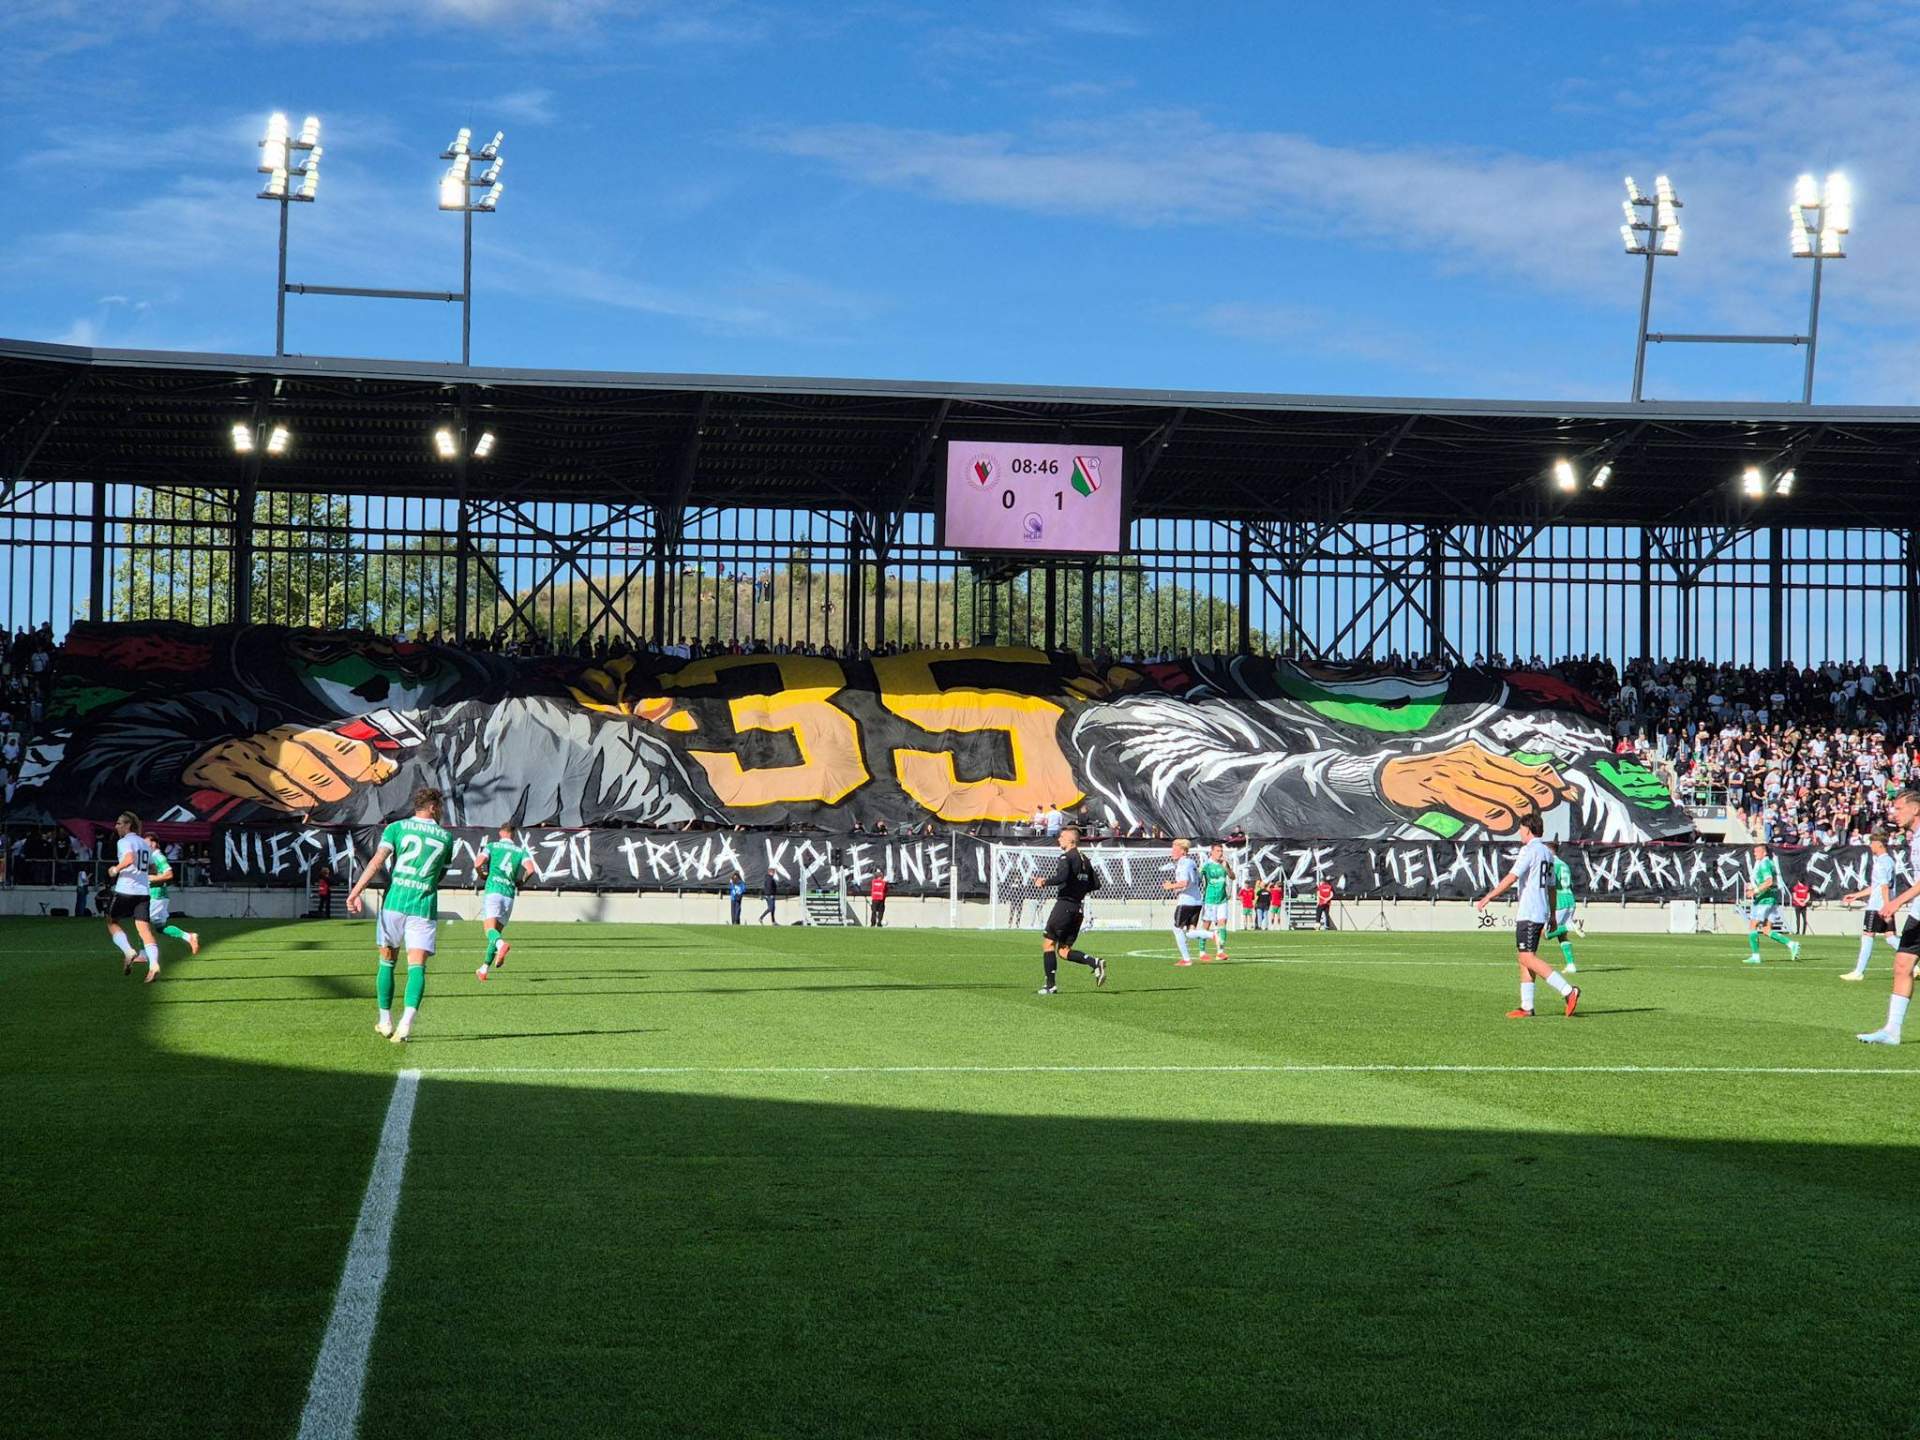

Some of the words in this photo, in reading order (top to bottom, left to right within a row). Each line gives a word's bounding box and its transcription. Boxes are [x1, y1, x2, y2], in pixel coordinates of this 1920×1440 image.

[1011, 458, 1059, 474] 08:46
[1002, 489, 1015, 509] 0
[1054, 491, 1064, 510] 1
[1697, 808, 1709, 817] 07
[137, 849, 149, 872] 19
[224, 829, 360, 876] NIECH
[618, 832, 746, 881] TRWA
[765, 837, 951, 888] KOLEJNE
[395, 834, 444, 878] 27
[499, 851, 513, 876] 4
